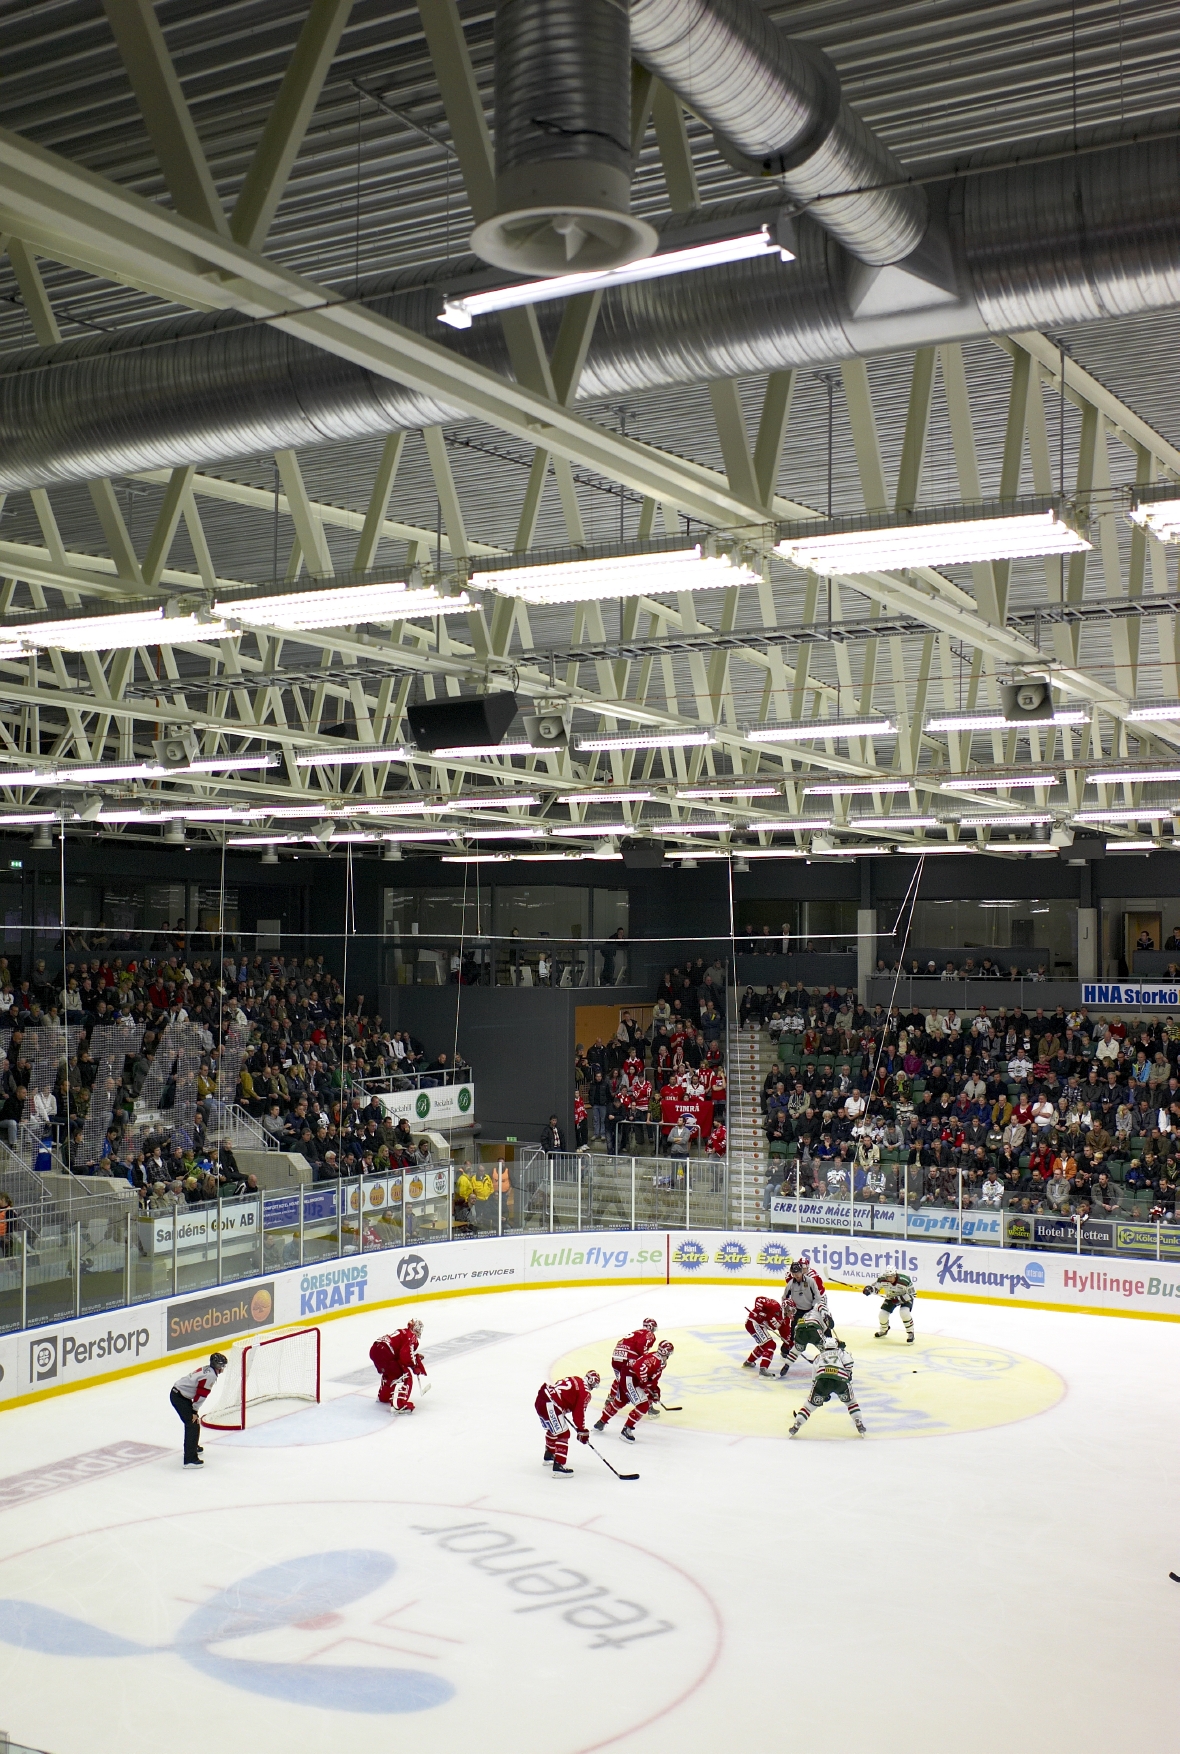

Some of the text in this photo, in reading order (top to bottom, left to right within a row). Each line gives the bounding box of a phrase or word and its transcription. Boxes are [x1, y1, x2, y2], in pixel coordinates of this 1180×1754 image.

[1084, 985, 1178, 1004] HNA Storkö
[675, 1103, 700, 1112] TIMRÅ
[774, 1202, 824, 1215] EKBLADHS
[211, 1217, 235, 1232] Golv
[240, 1212, 254, 1227] AB
[800, 1216, 863, 1228] LANDSKRONA
[901, 1213, 1000, 1236] Topflight
[1037, 1225, 1109, 1241] Hotel Pletten
[530, 1247, 663, 1268] kullaflyg.se
[672, 1251, 709, 1263] Extra
[714, 1252, 751, 1264] Extra
[756, 1253, 793, 1265] Extra
[801, 1244, 919, 1271] stigbertils
[300, 1265, 368, 1292] ÖRESUNDS
[400, 1255, 515, 1283] ISS FACILITY SERVICES
[936, 1252, 1030, 1294] Kinnarps
[301, 1279, 368, 1316] KRAFT
[170, 1302, 249, 1337] Swedbank
[62, 1328, 150, 1367] Perstorp
[408, 1521, 676, 1650] telenor
